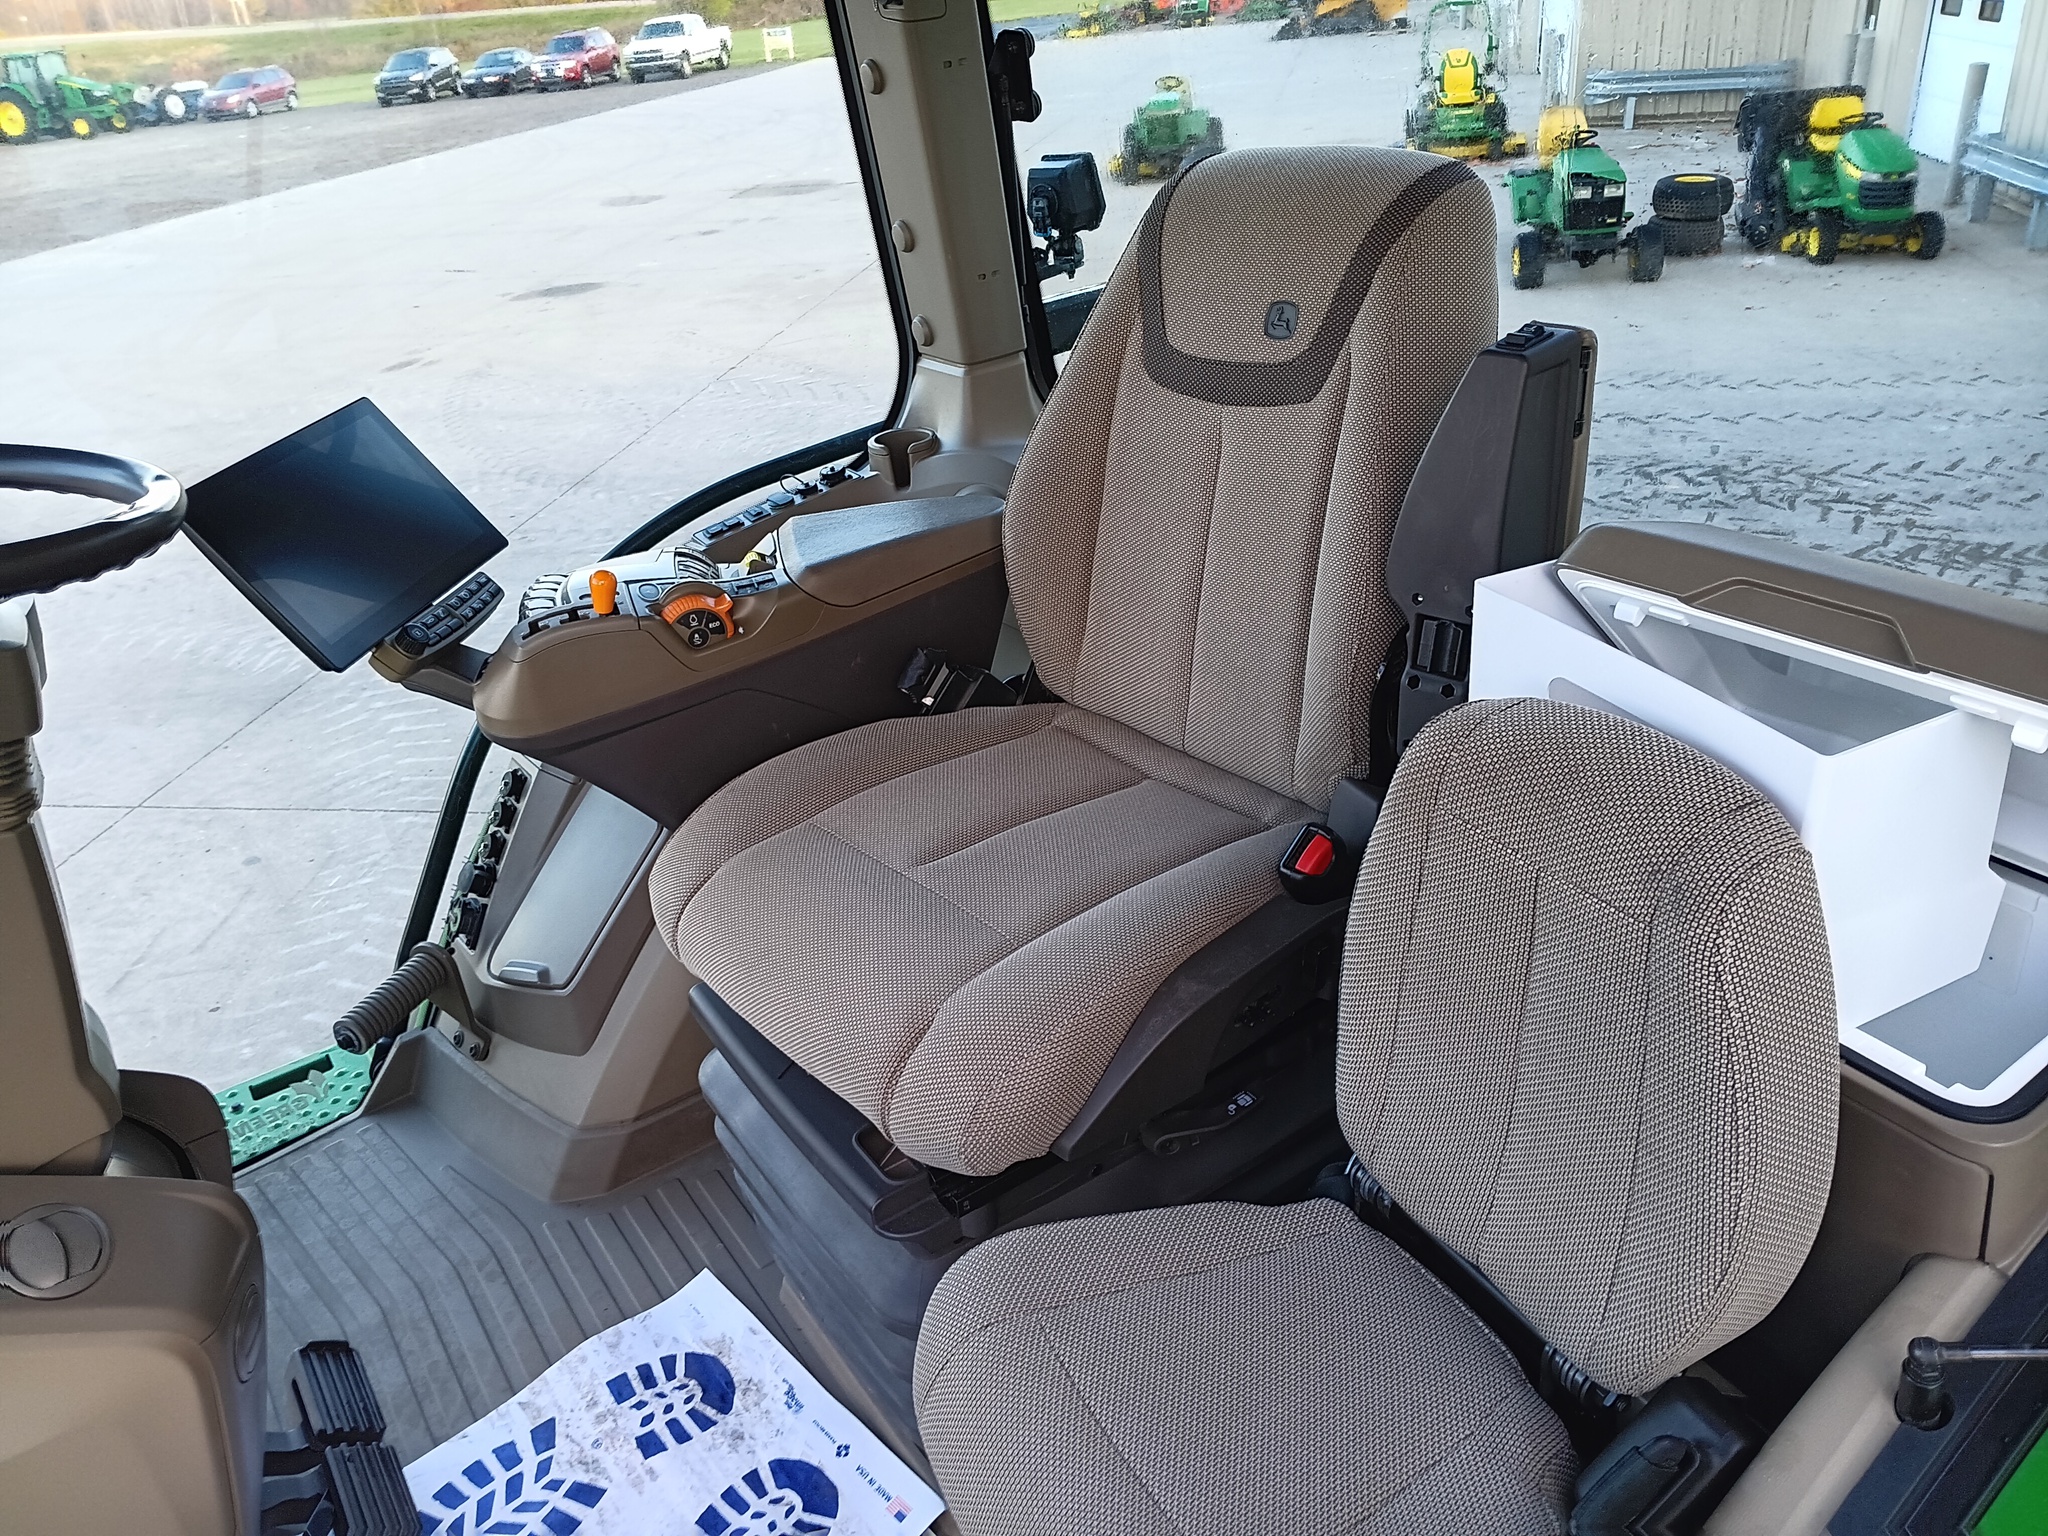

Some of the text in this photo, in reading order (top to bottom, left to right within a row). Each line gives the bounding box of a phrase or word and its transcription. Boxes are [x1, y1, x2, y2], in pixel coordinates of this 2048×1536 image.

[855, 1464, 893, 1503] MADE IN USA
